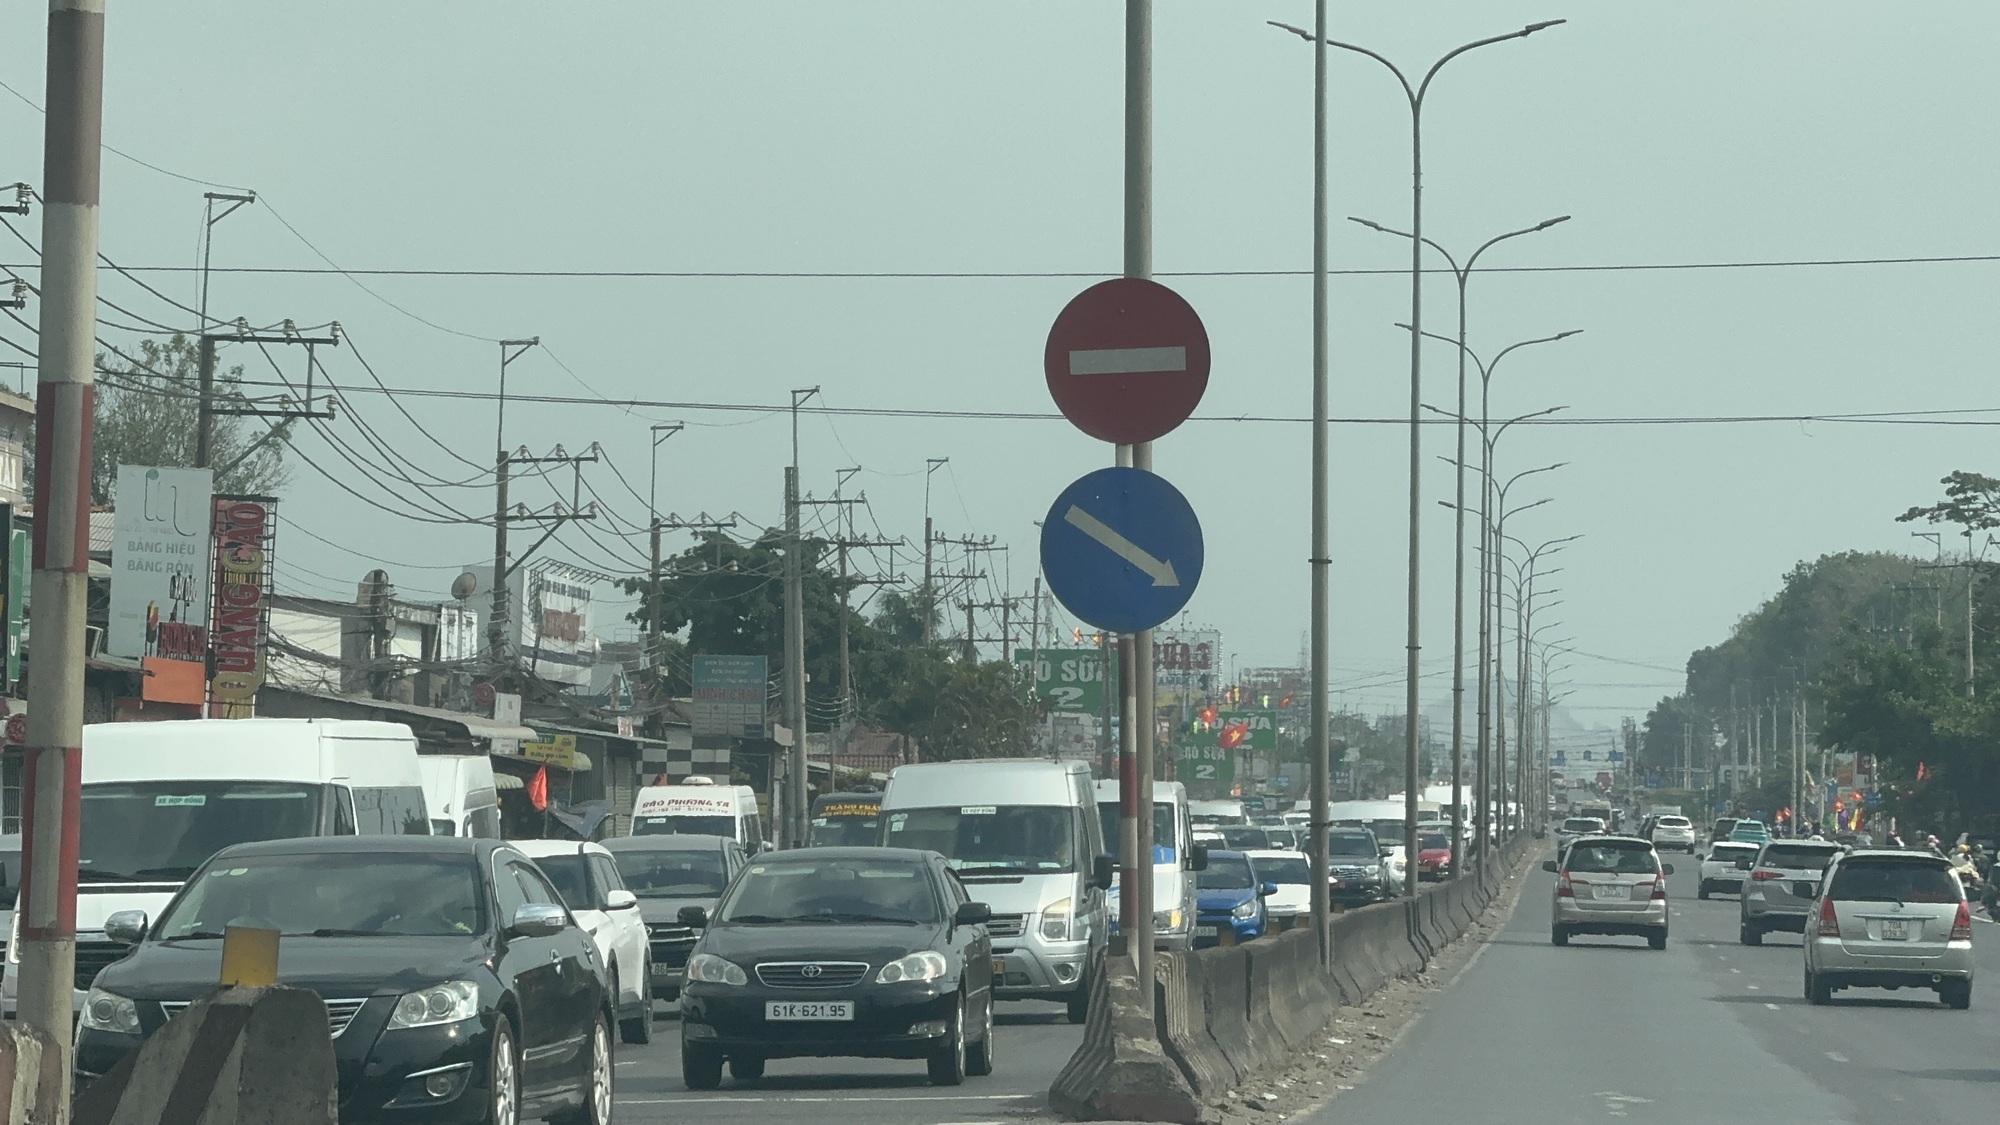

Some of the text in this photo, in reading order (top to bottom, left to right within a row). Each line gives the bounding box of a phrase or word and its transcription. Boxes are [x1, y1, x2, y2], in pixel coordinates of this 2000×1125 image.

[127, 536, 196, 558] BẢNG HIỆU
[1049, 687, 1084, 708] 2
[1195, 765, 1216, 779] 2
[773, 1004, 846, 1018] 61K-621.95
